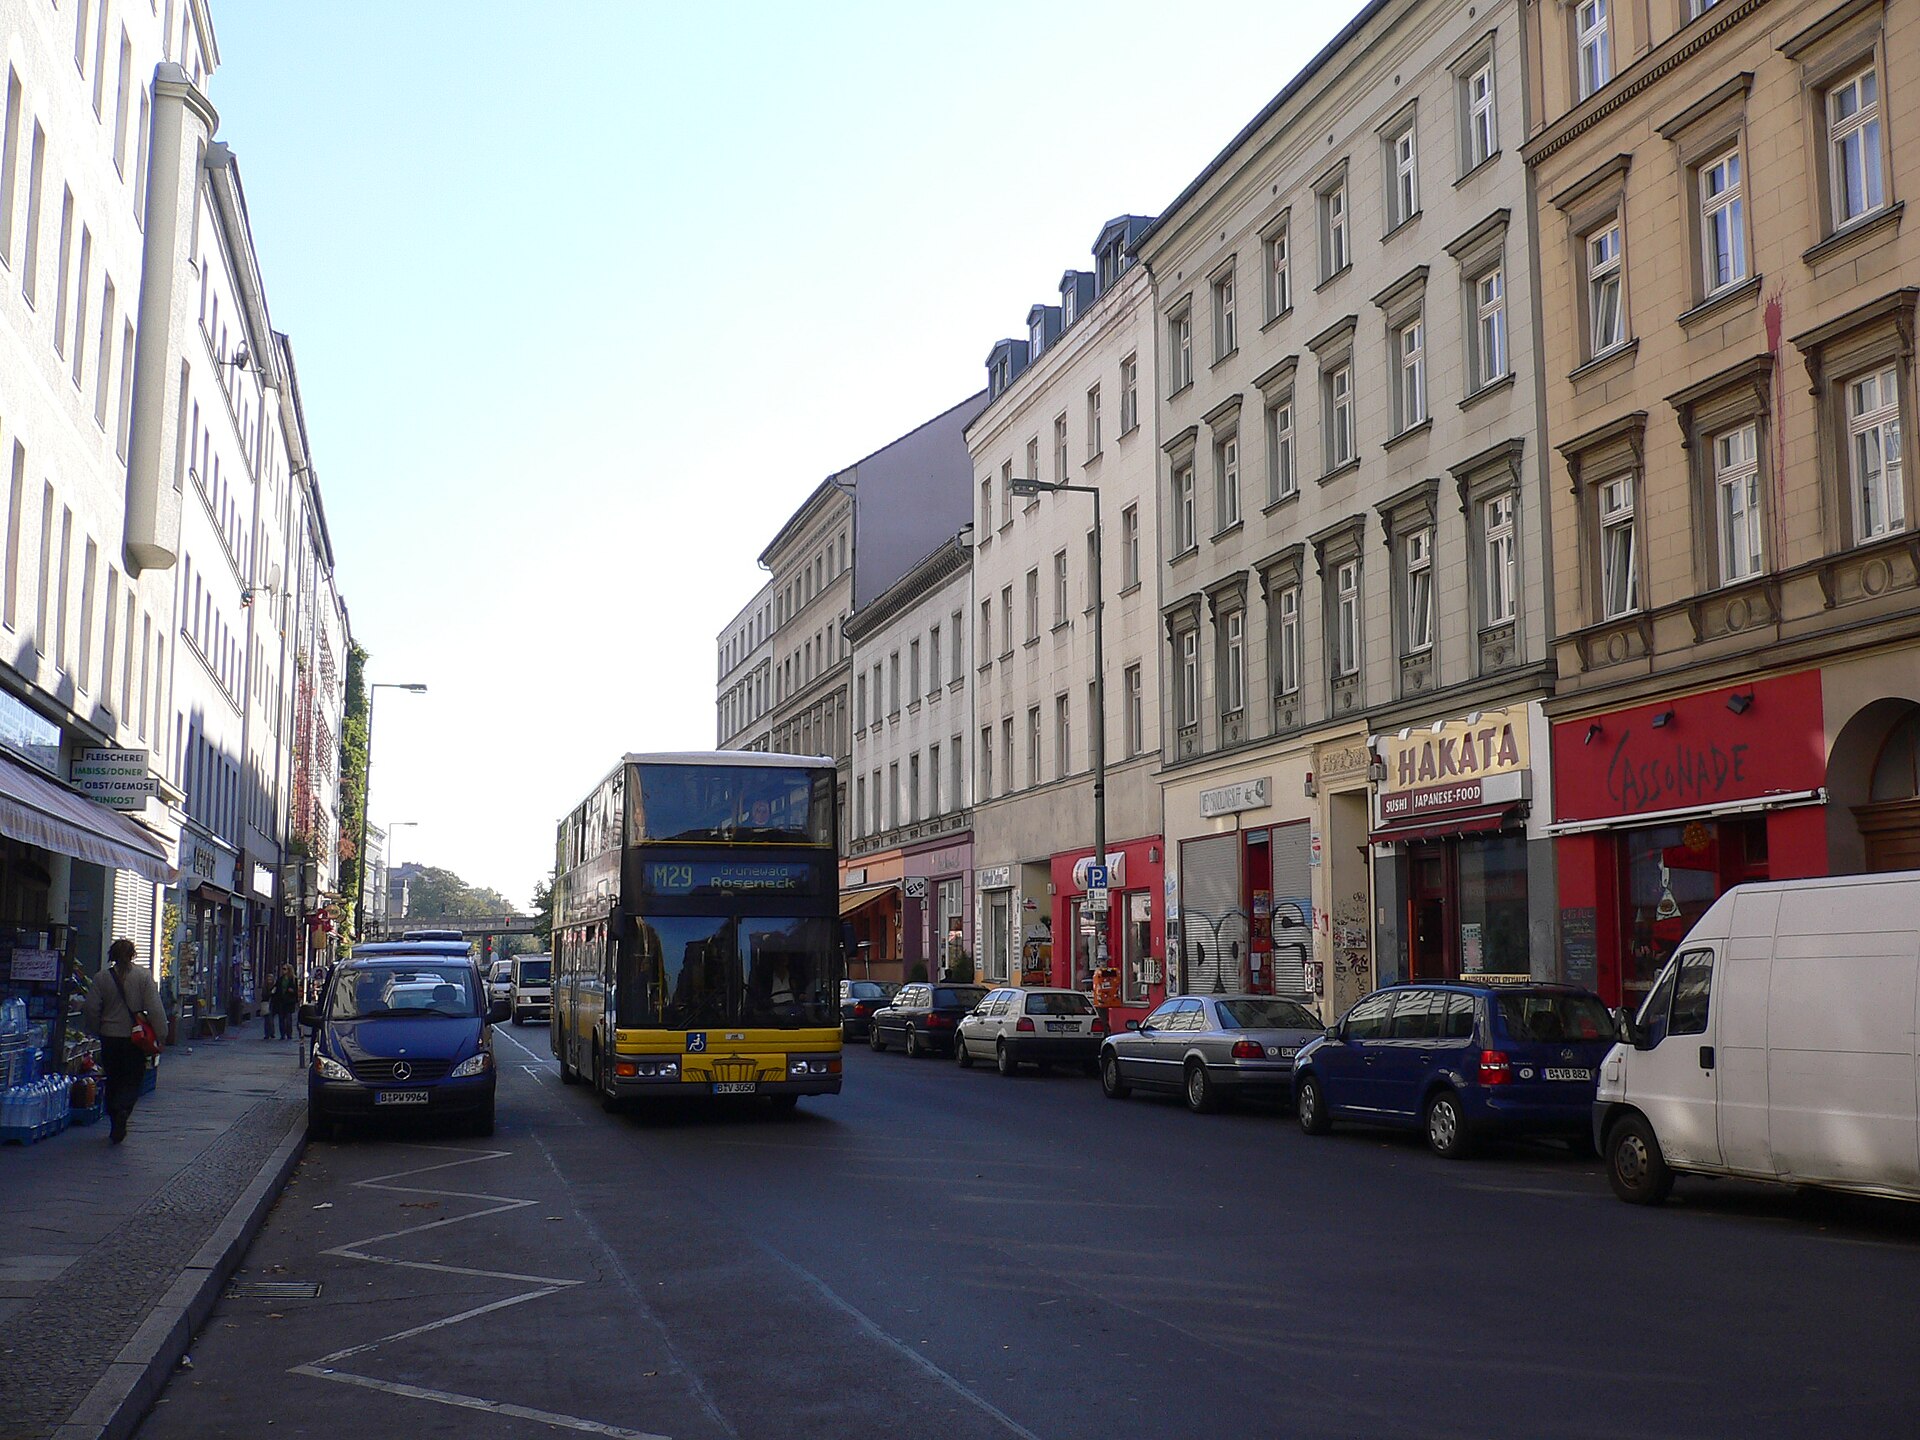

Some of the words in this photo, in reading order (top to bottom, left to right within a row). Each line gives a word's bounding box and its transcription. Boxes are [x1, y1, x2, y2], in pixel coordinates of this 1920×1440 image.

[86, 753, 144, 762] FLEISCHEREI
[1398, 723, 1519, 786] HAKATA
[1608, 729, 1748, 811] CASSONADE
[84, 781, 154, 791] OBST/GEMÜSE
[1385, 797, 1408, 813] SUSHI
[1414, 786, 1481, 808] JAPANESE-FOOD
[654, 865, 693, 888] M29
[711, 877, 795, 889] Roseneck
[1091, 868, 1103, 887] P
[906, 880, 924, 896] Eis
[1572, 1069, 1588, 1078] 882
